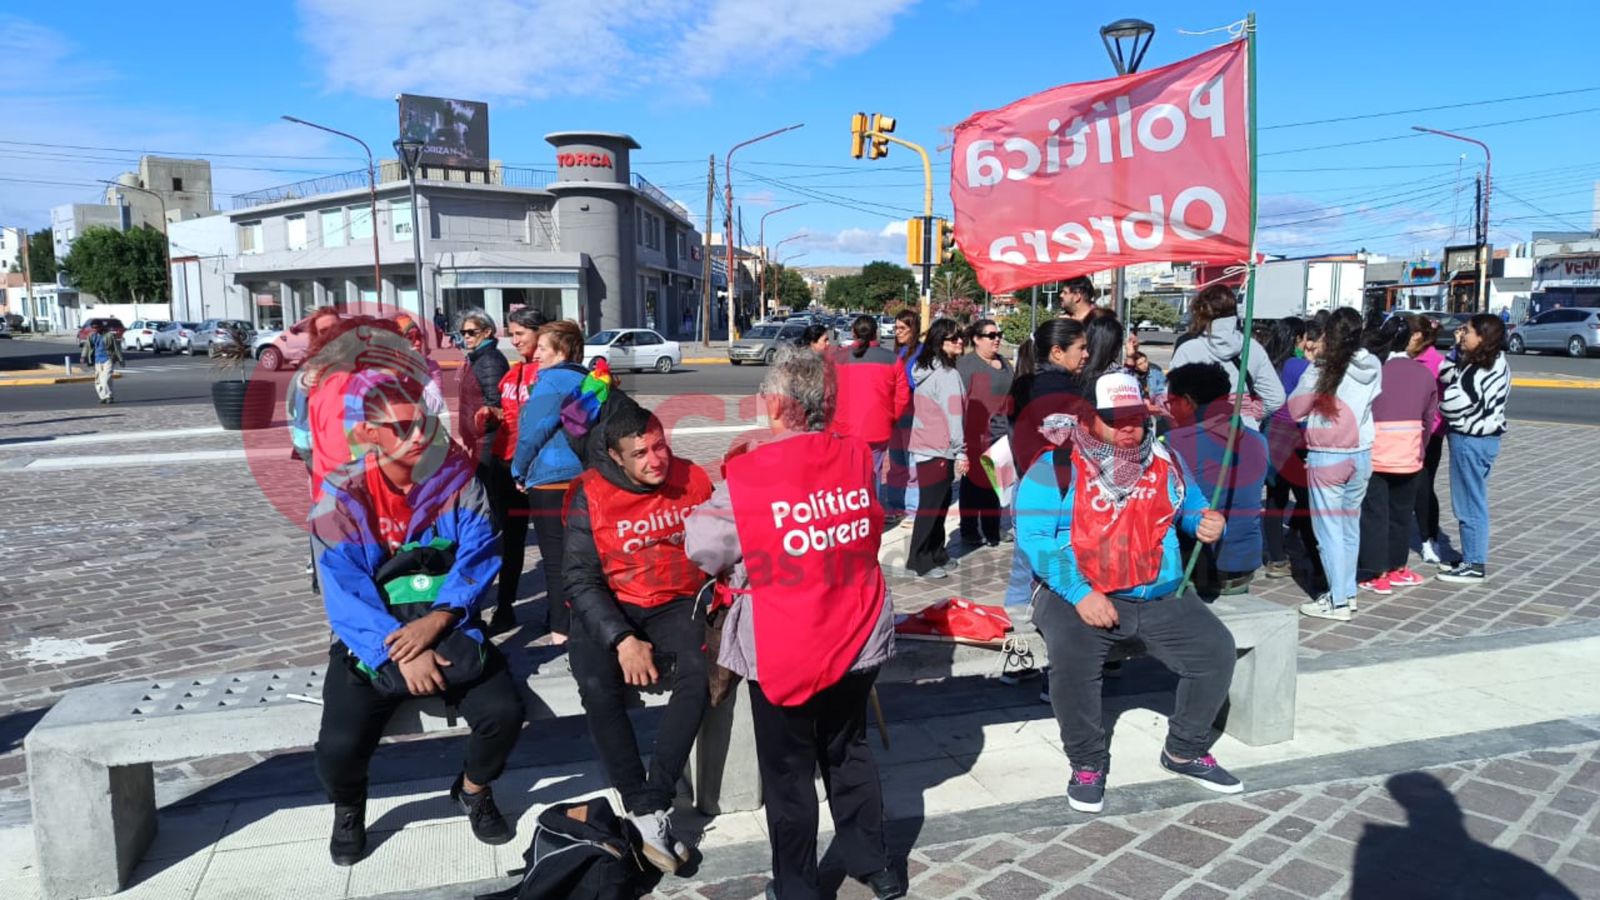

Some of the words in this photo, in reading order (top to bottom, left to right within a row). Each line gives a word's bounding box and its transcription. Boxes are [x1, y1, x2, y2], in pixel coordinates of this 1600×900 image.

[556, 151, 612, 169] TORCA
[616, 504, 699, 539] Polític
[771, 486, 870, 529] Política
[783, 517, 870, 557] Obrera
